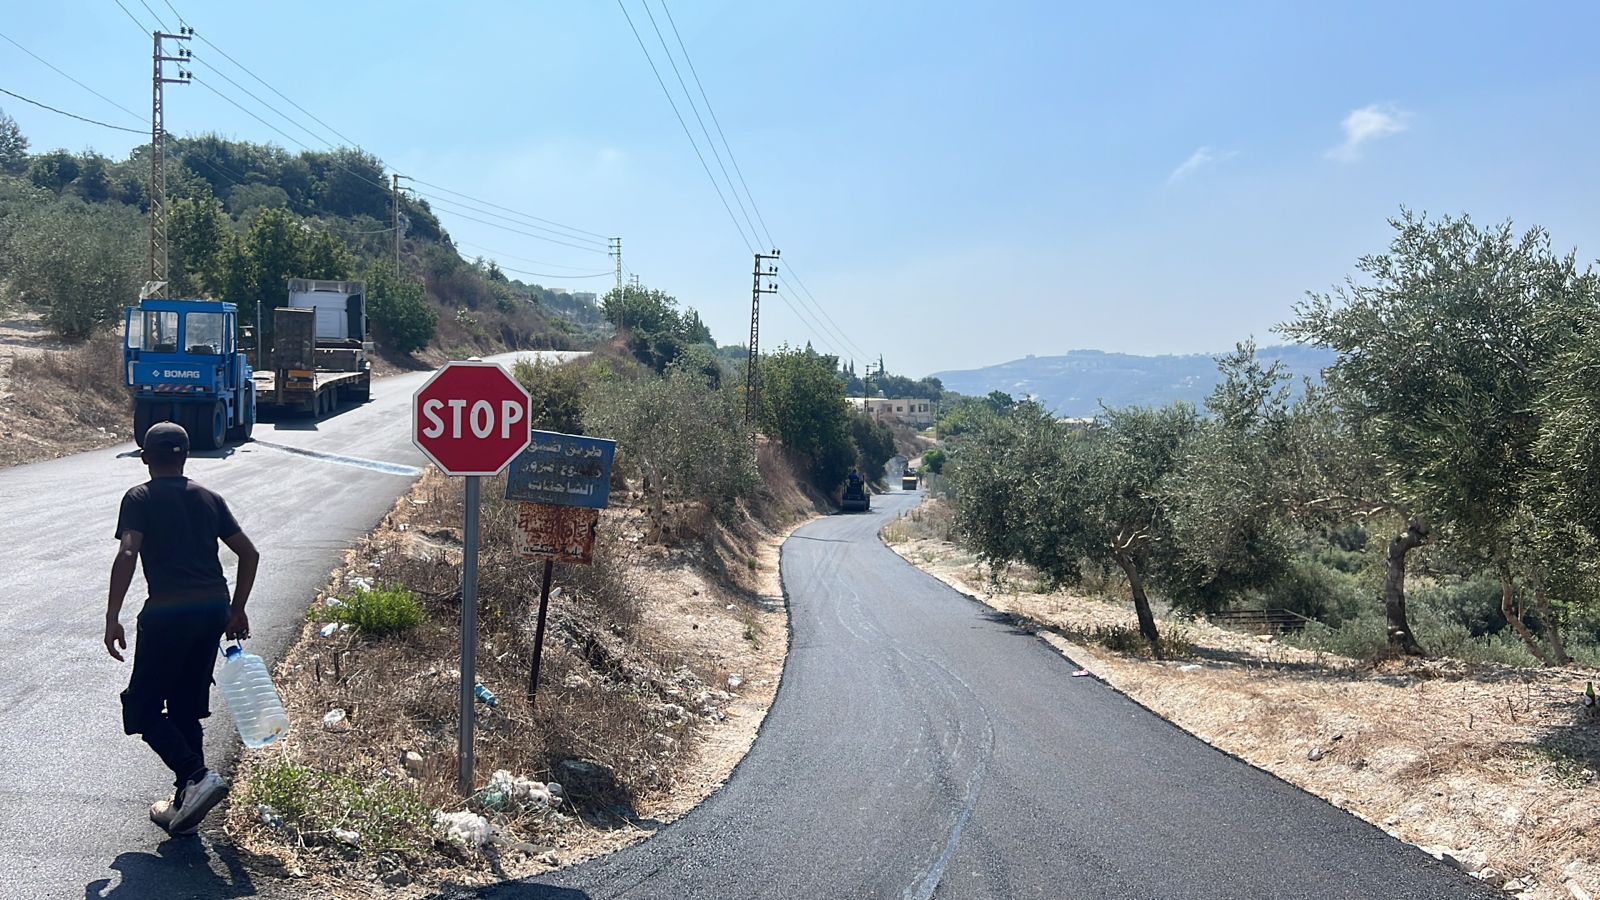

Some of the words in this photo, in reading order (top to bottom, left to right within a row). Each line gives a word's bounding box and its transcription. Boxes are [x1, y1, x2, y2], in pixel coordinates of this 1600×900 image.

[164, 370, 200, 378] BOMAG
[422, 399, 524, 439] STOP
[527, 439, 561, 453] ضيق
[565, 443, 602, 457] طريق
[528, 480, 594, 496] الشاحنات
